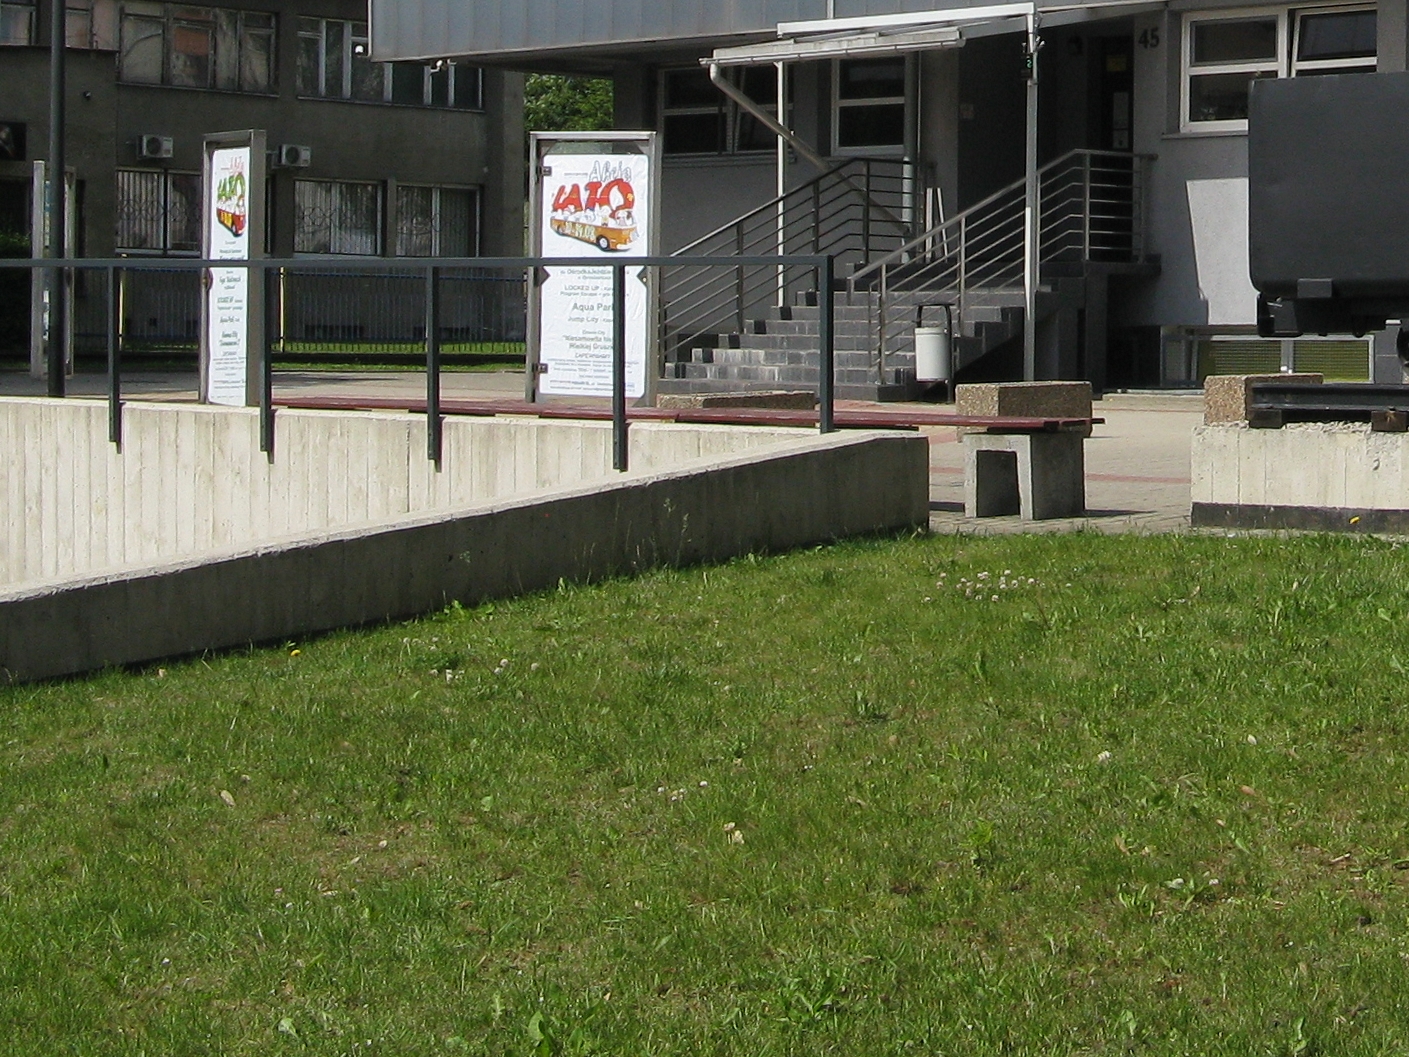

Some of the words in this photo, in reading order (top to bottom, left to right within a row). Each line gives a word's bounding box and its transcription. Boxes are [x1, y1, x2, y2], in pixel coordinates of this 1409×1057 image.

[1138, 27, 1160, 49] 45
[552, 178, 635, 218] LATO
[572, 302, 594, 313] Aqua
